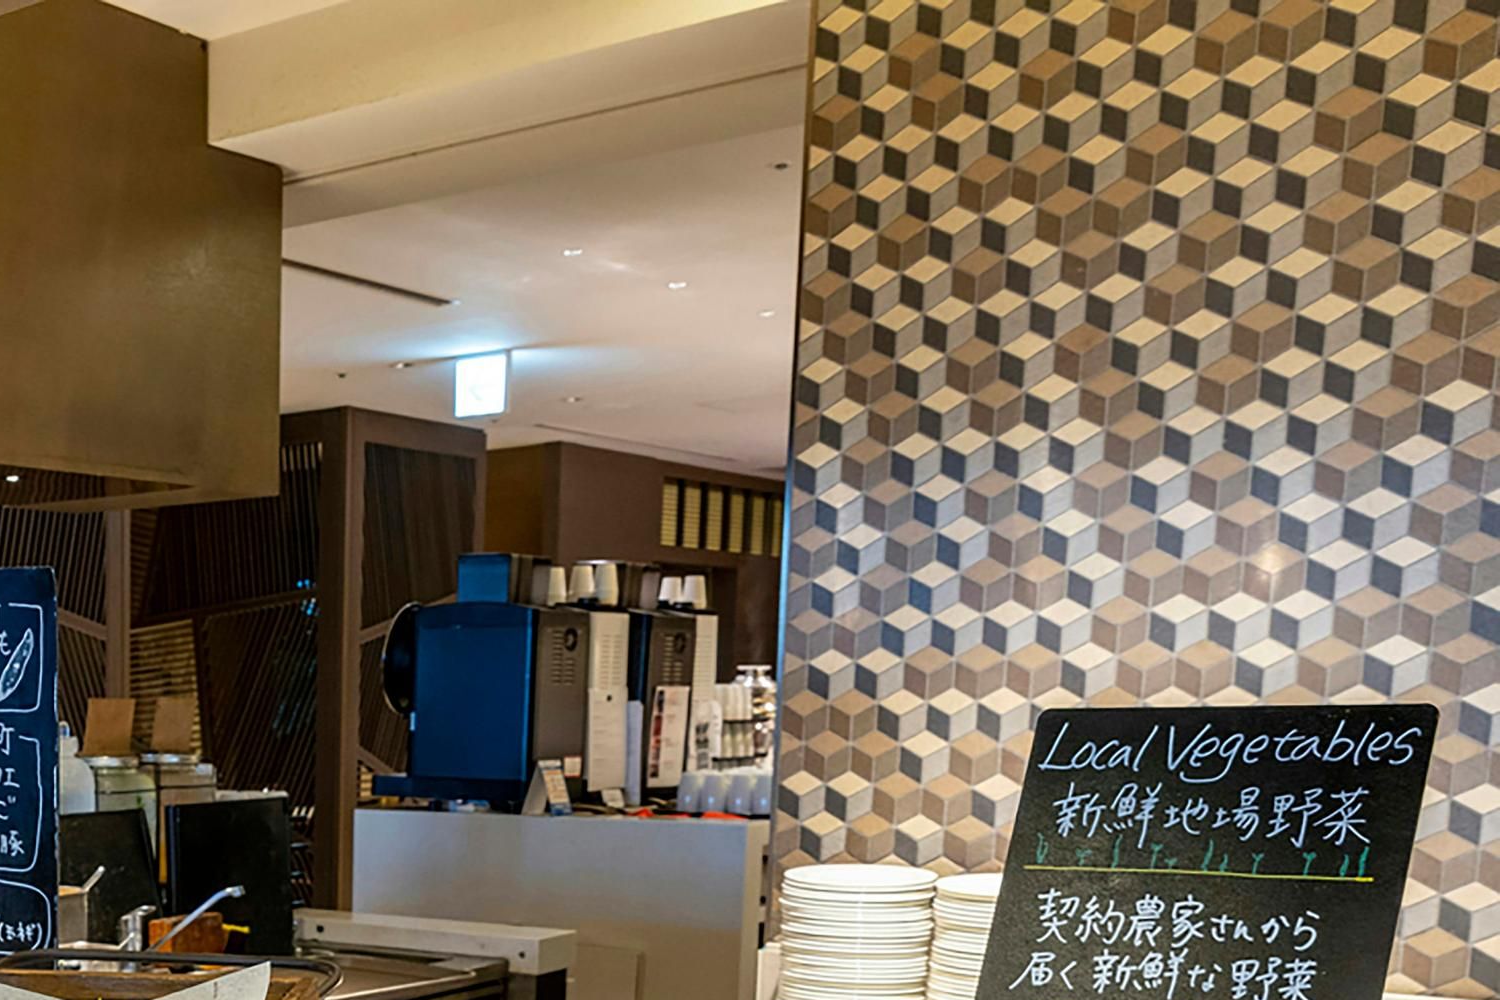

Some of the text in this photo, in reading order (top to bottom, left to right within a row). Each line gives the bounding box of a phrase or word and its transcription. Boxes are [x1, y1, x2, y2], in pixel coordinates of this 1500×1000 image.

[1037, 718, 1423, 784] Local Vegetables
[1051, 781, 1373, 850] 新鮮地場野菜
[1035, 887, 1322, 952] 契約農家さんから
